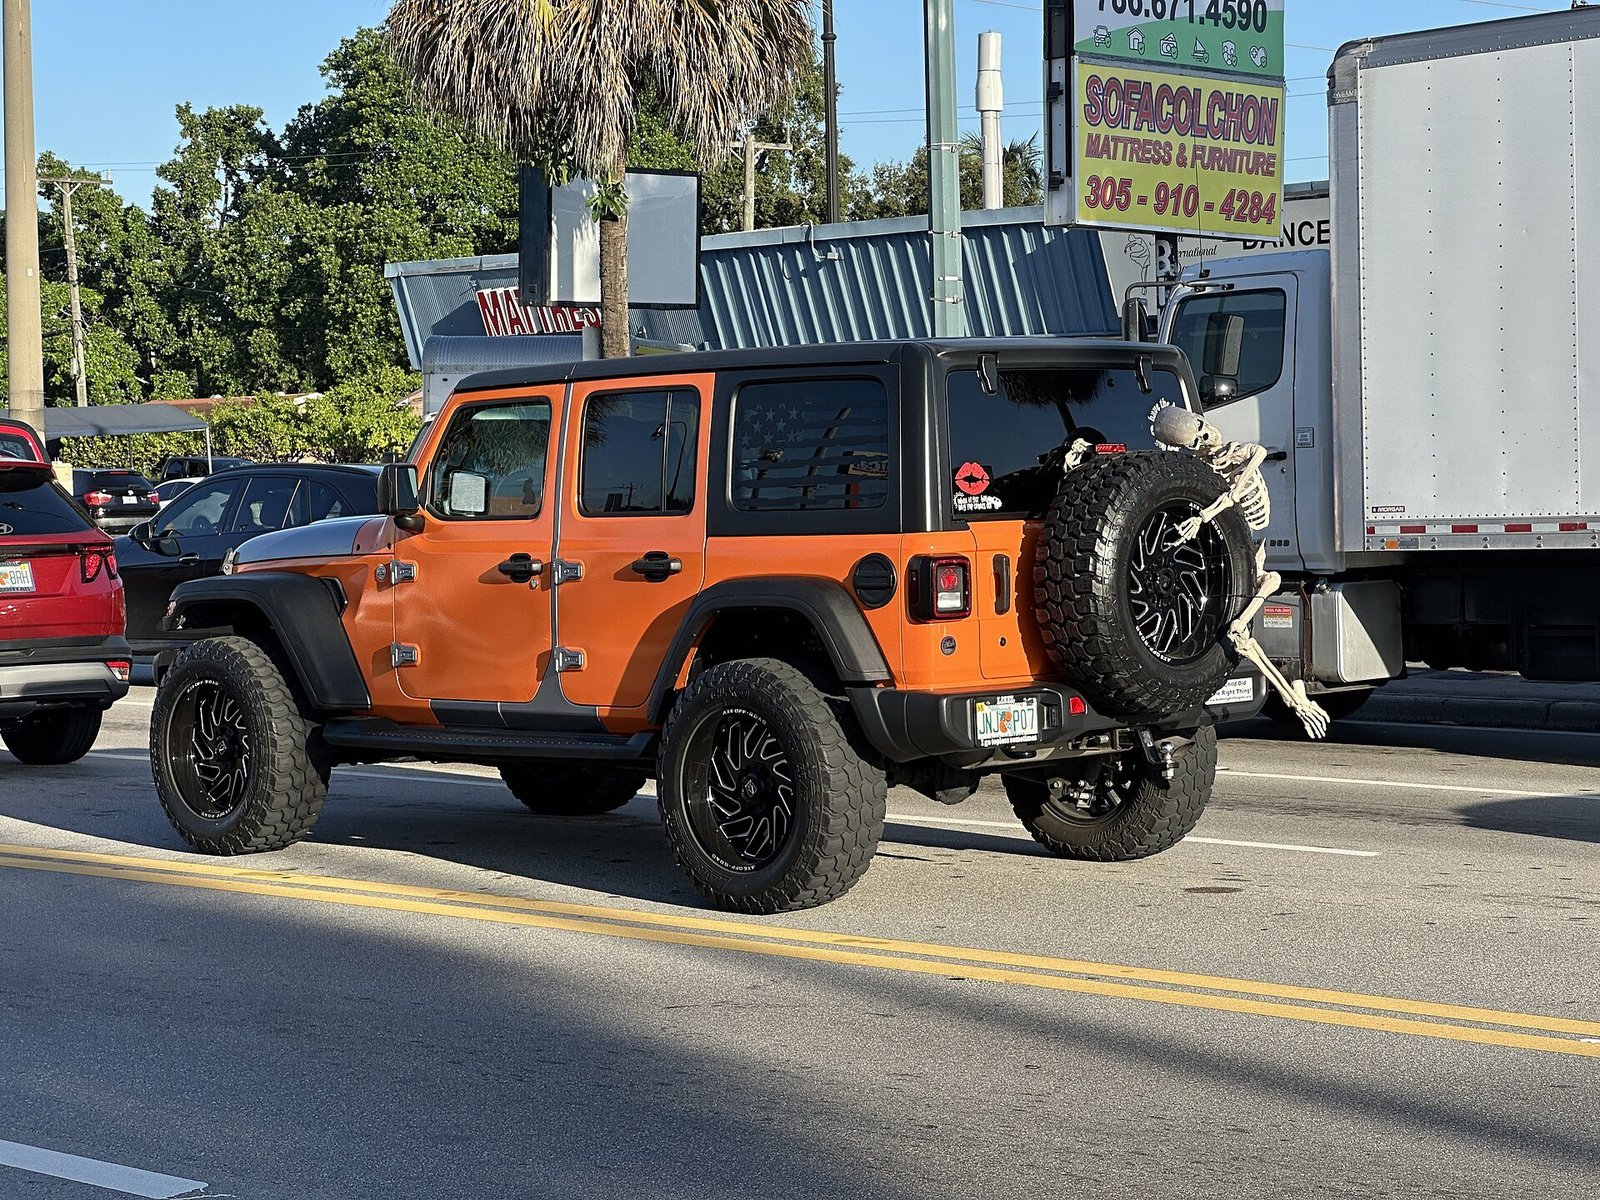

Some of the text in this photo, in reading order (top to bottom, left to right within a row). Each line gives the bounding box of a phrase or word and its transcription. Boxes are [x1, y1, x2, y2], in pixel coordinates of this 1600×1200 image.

[1098, 0, 1268, 33] .671.4590
[1084, 74, 1279, 146] SOFACOLCHON
[1085, 133, 1277, 177] MATTRESS & FURNITURE
[1084, 175, 1133, 212] 305
[1154, 181, 1198, 218] 910
[1219, 189, 1277, 224] 4284
[1177, 245, 1218, 258] rnational
[1243, 220, 1330, 249] NCE
[476, 286, 601, 337] MATTRE
